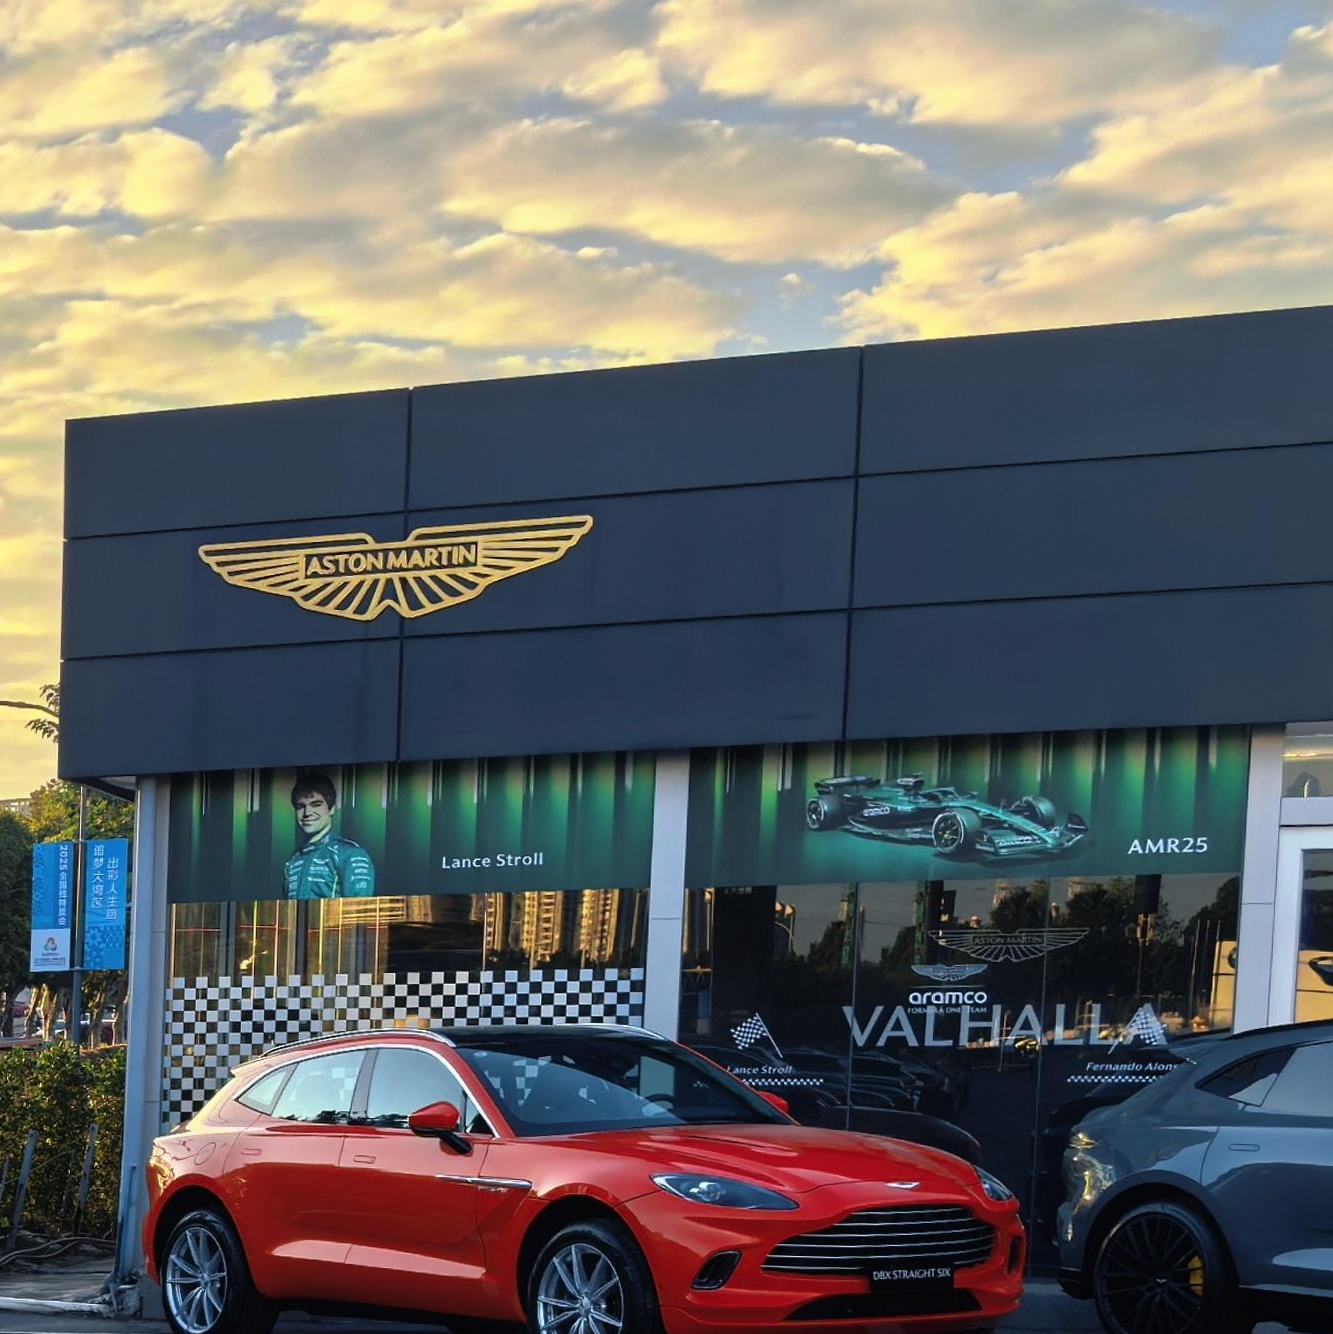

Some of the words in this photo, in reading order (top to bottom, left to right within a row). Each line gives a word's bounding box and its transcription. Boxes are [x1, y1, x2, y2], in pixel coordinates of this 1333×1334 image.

[306, 551, 384, 576] ASTON
[386, 545, 476, 571] MARTIN
[1127, 836, 1209, 855] AMR25
[442, 856, 491, 869] Lance
[496, 852, 544, 867] Stroll
[908, 990, 988, 1006] aramco
[841, 1002, 1169, 1048] VALHALLA
[1085, 1061, 1143, 1072] Fernando
[892, 1268, 936, 1280] STRAIGHT
[936, 1267, 951, 1278] SIX
